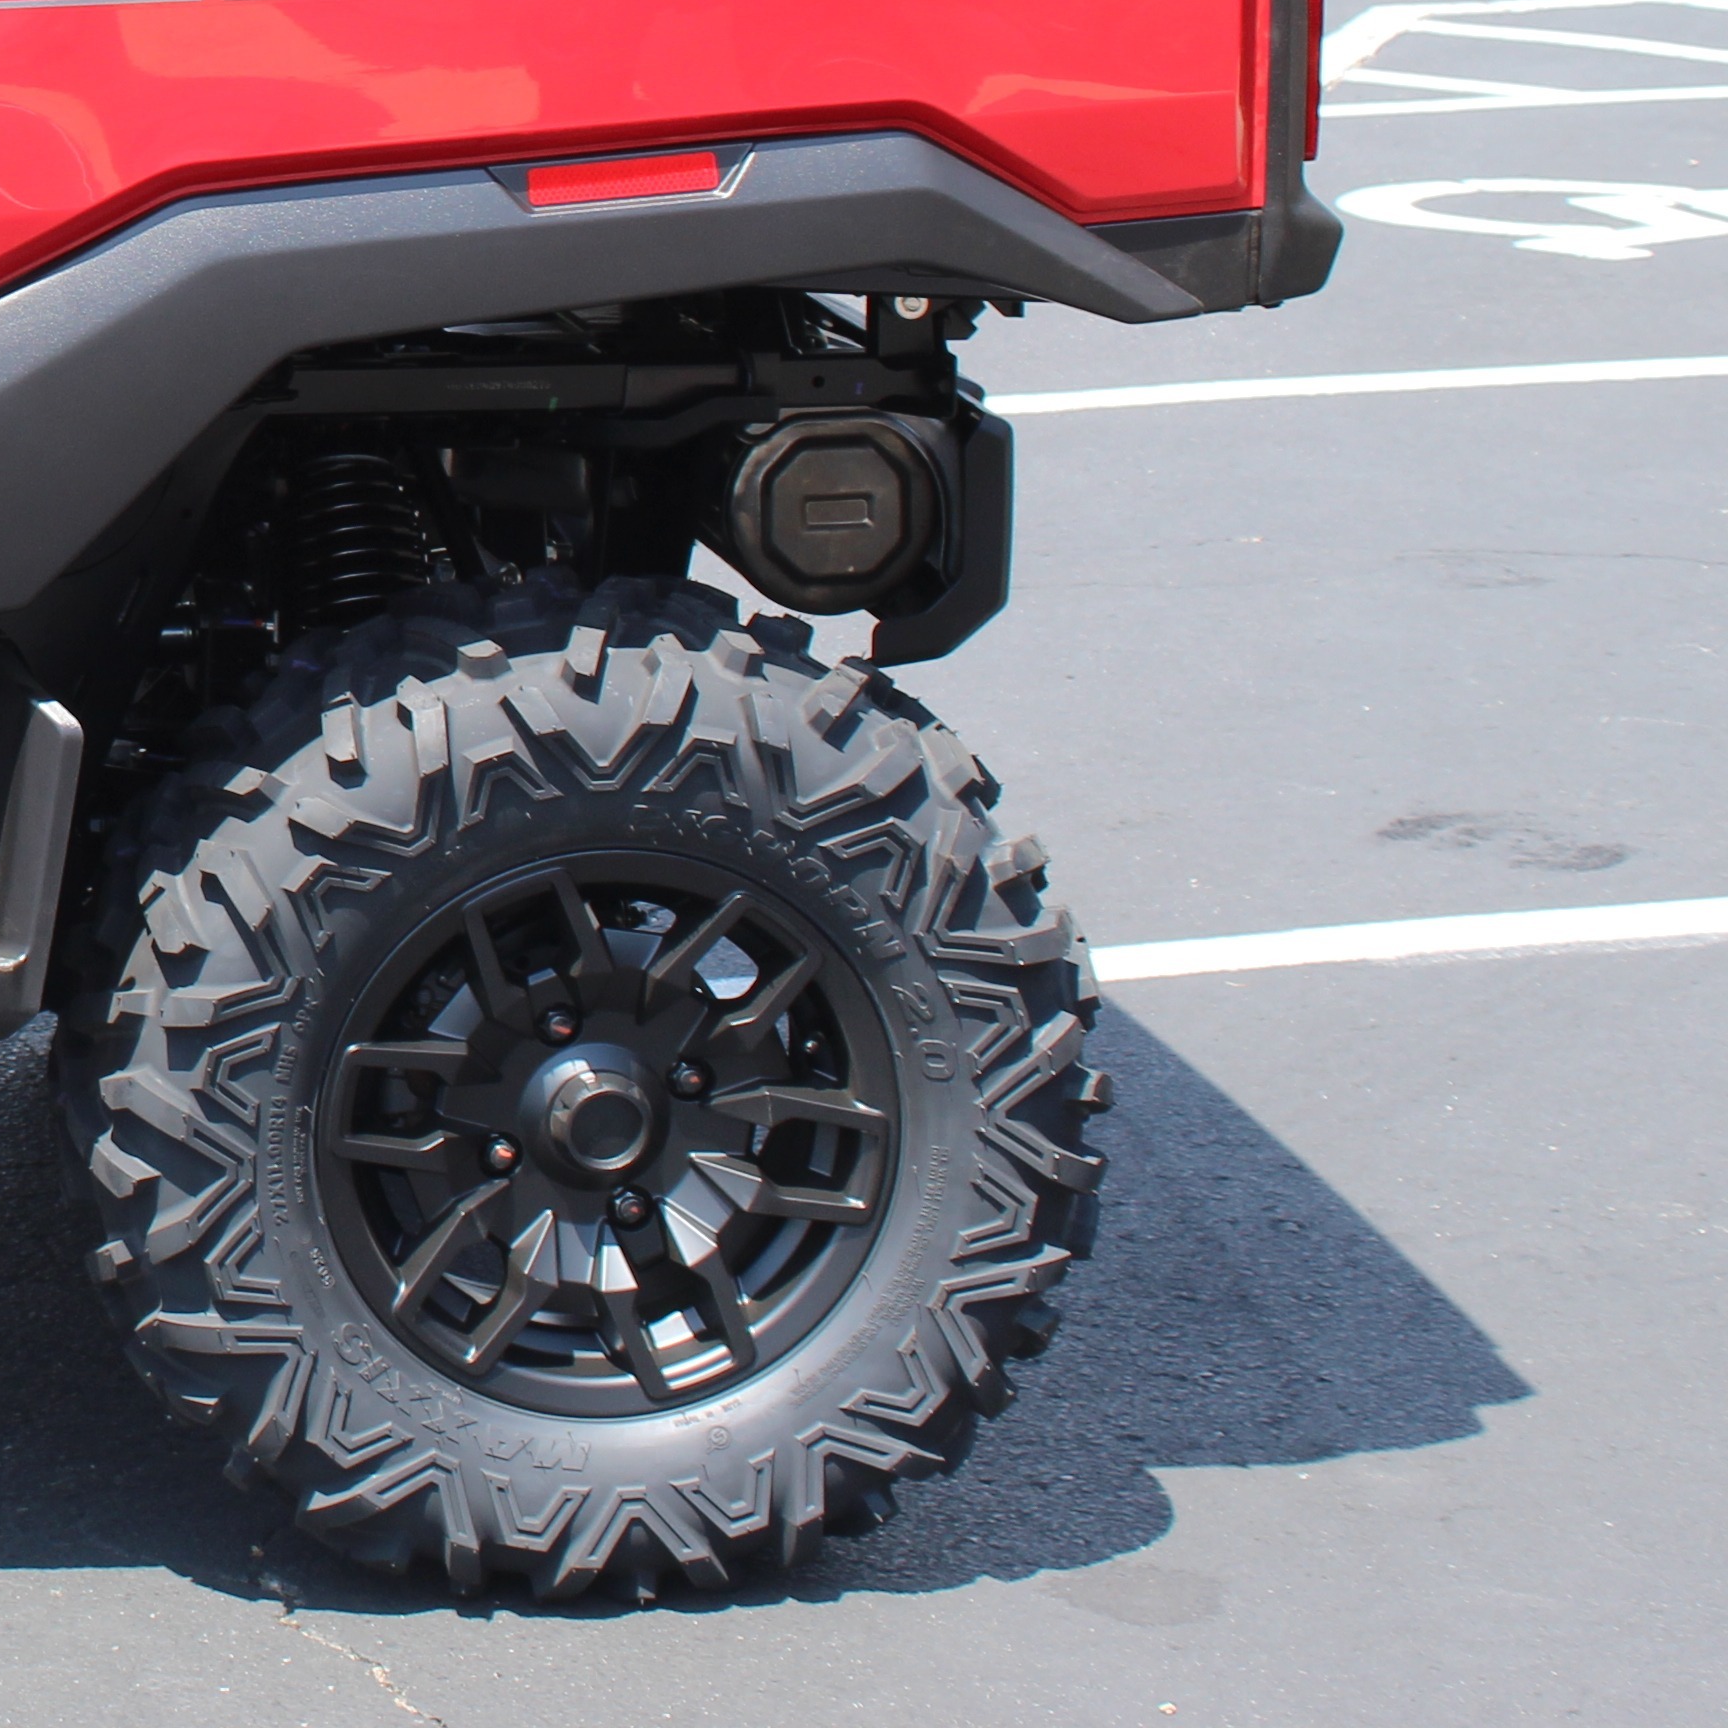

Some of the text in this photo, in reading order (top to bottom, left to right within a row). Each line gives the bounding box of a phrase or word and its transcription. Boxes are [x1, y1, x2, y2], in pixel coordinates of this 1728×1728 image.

[275, 1043, 297, 1085] NHS
[891, 981, 957, 1081] 2.0
[331, 1322, 591, 1472] MAXXIS
